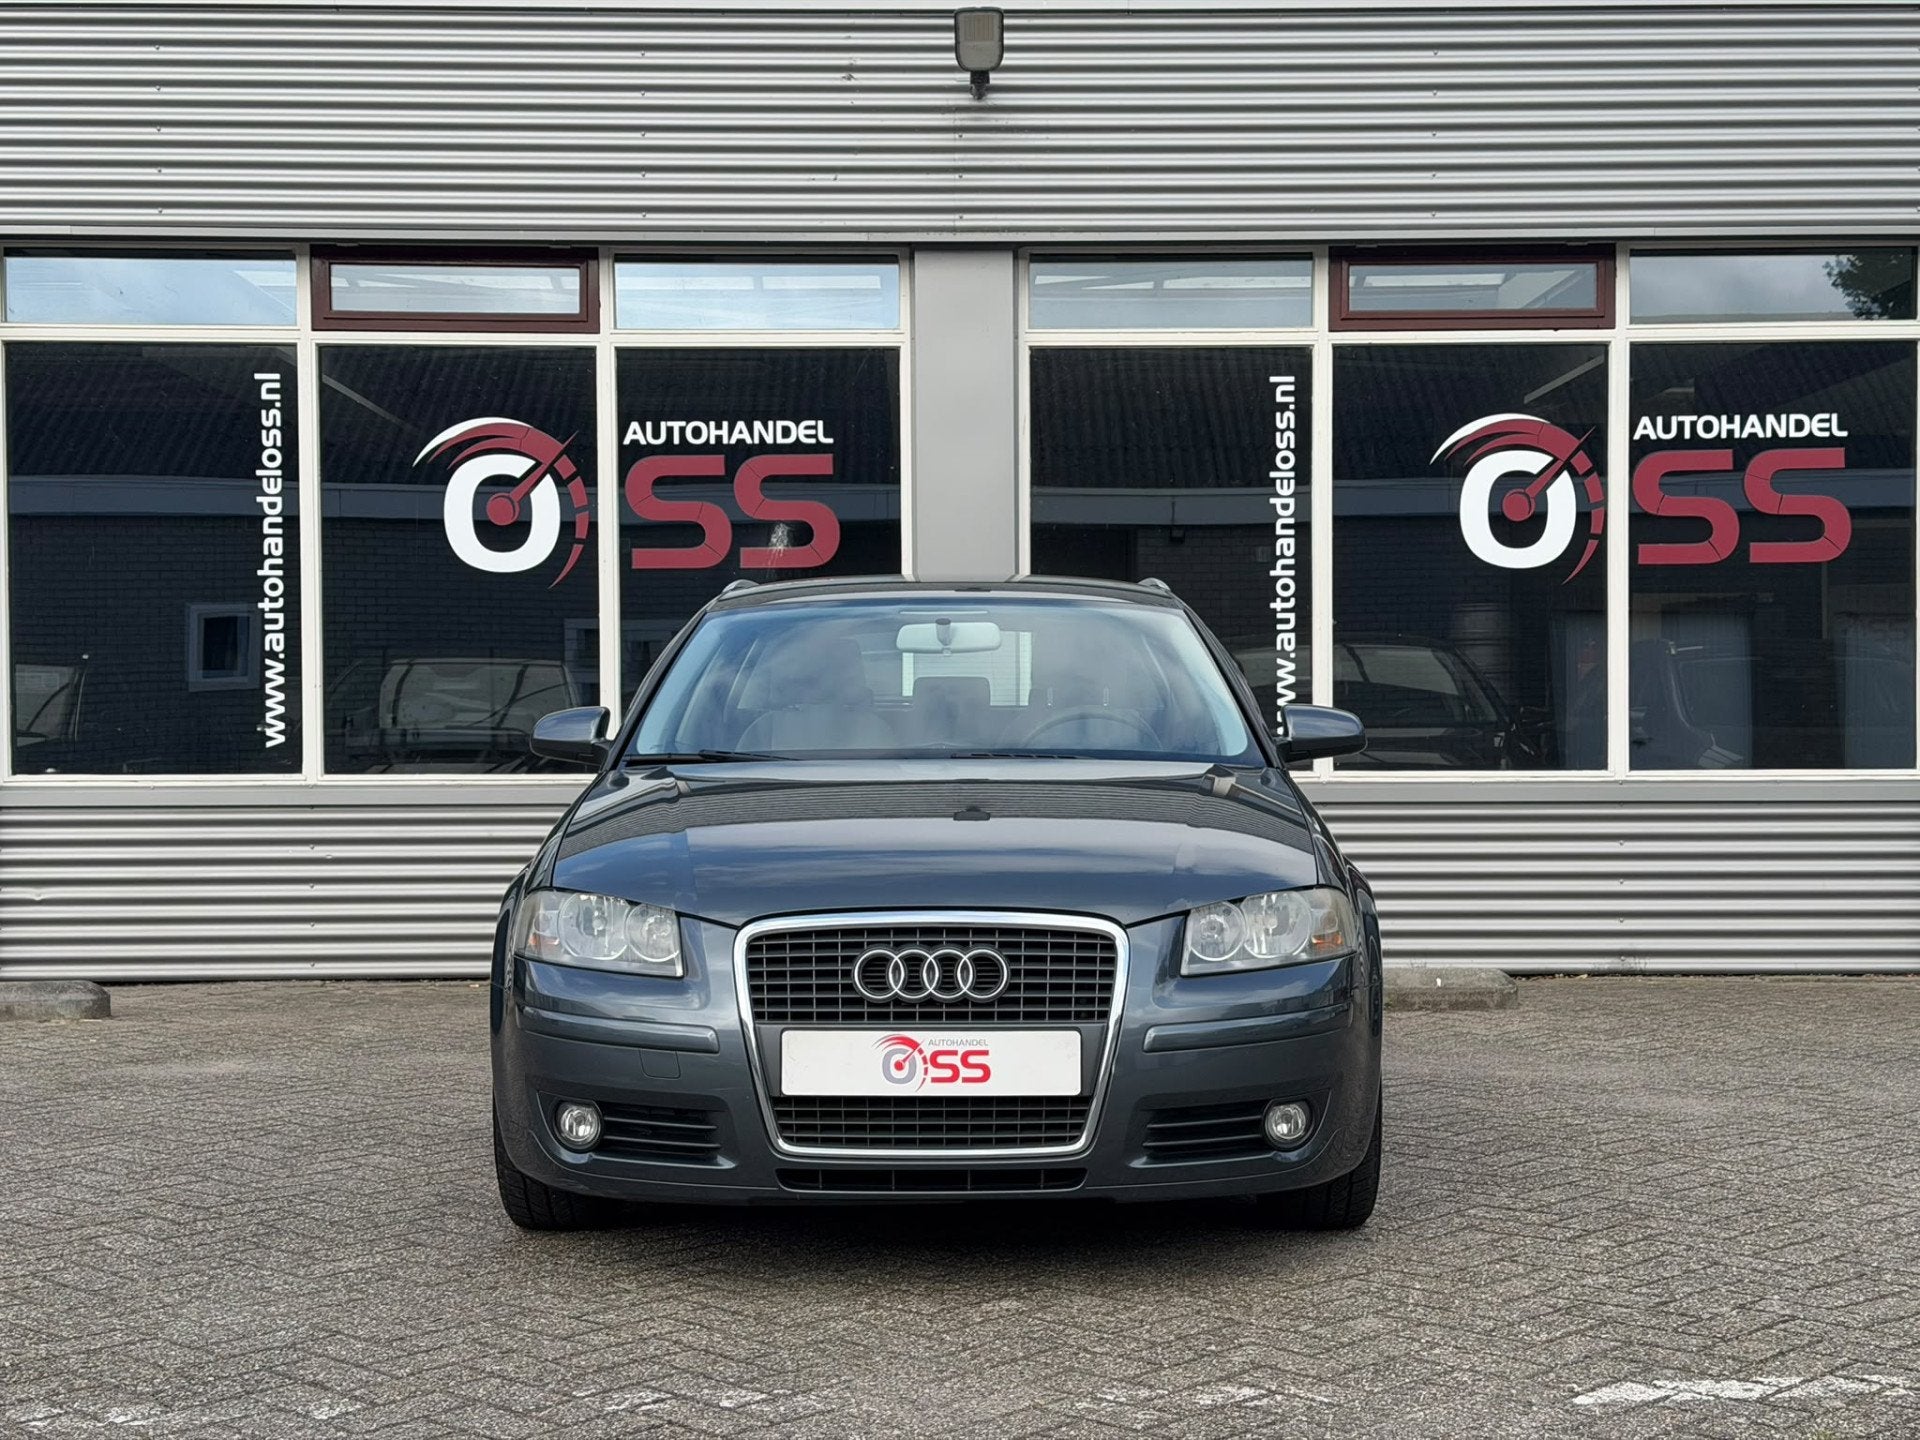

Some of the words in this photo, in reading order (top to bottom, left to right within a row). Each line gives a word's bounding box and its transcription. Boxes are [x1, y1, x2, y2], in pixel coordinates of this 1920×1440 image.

[623, 420, 834, 445] AUTOHANDEL
[1633, 413, 1848, 440] AUTOHANDEL
[443, 453, 841, 573] OSS
[1459, 447, 1852, 569] OSS
[254, 373, 286, 748] www.autohandeloss.nl
[1269, 376, 1296, 735] ww.autohandeloss.nl
[881, 1047, 992, 1085] OSS
[928, 1039, 989, 1047] AUTOHANDEL
